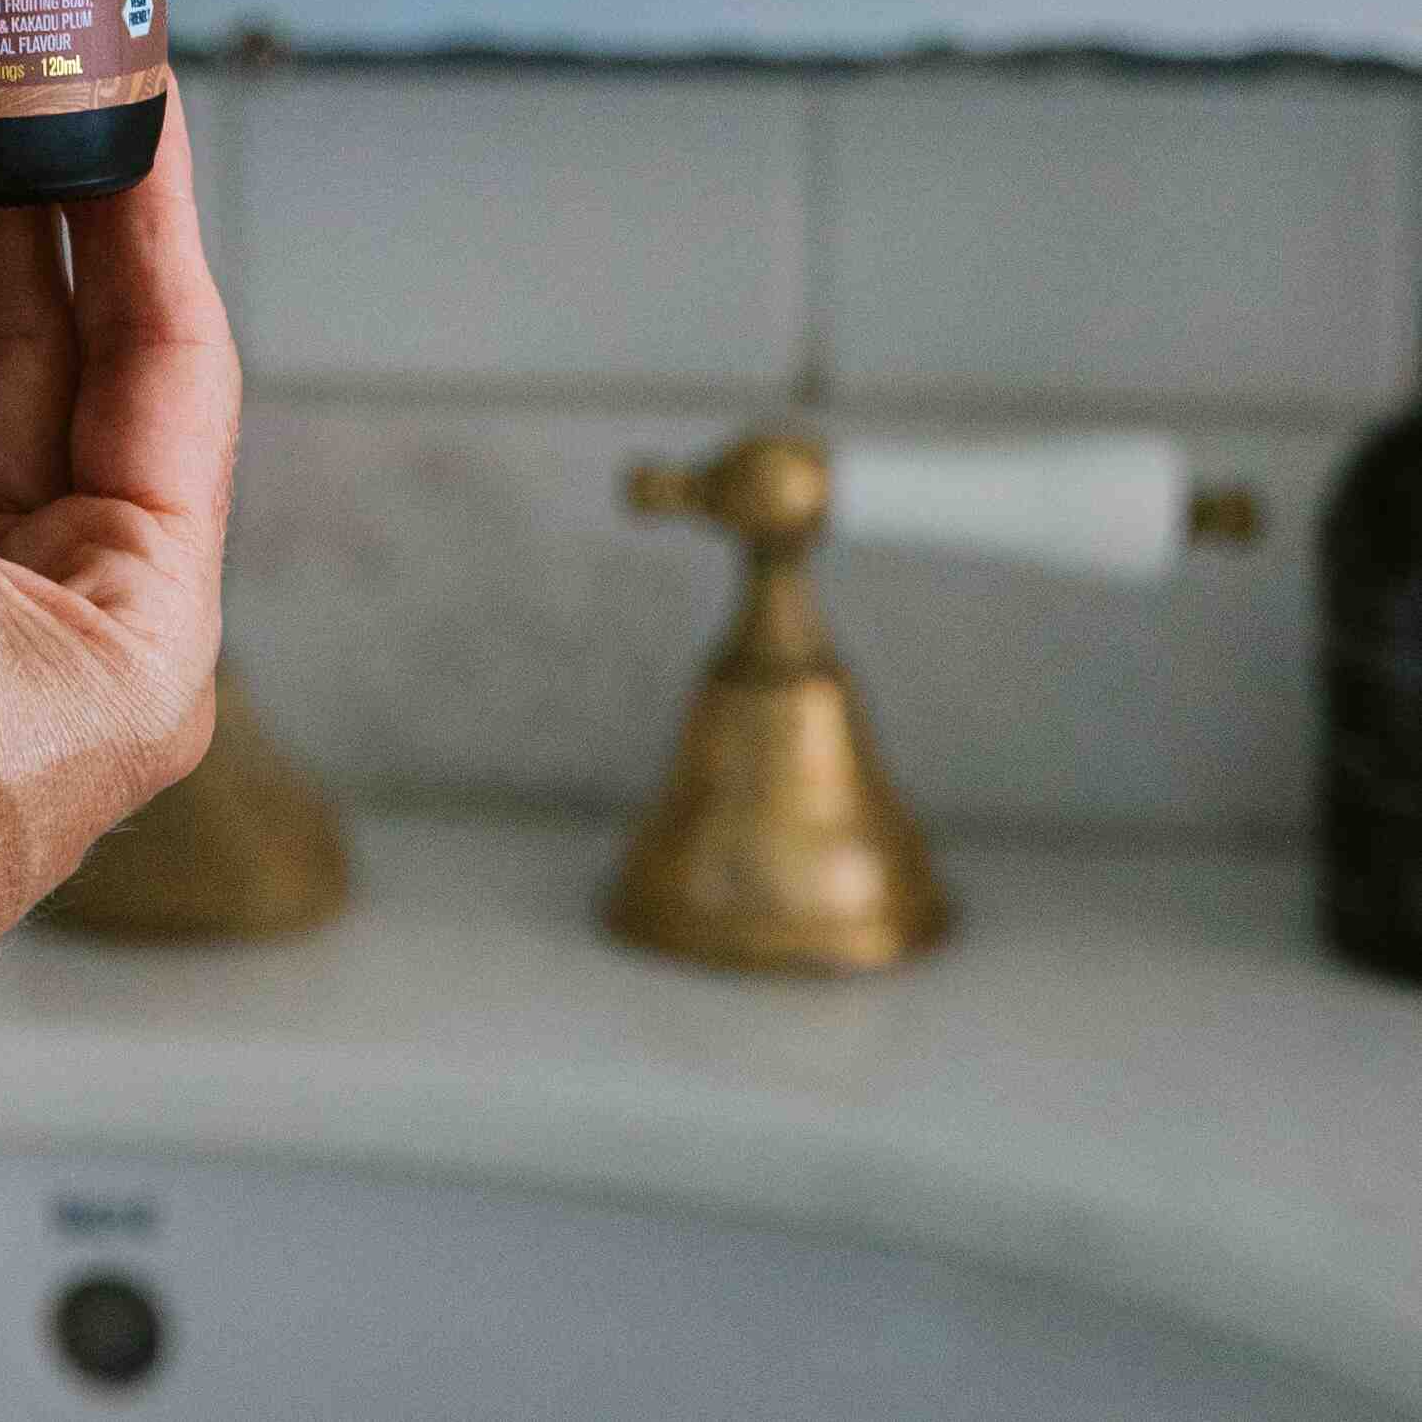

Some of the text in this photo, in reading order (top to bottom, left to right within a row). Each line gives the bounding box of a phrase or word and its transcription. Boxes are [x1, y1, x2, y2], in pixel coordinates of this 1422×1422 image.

[11, 14, 59, 33] KAKADU
[61, 10, 93, 30] PLUM
[18, 32, 72, 54] FLAVOUR
